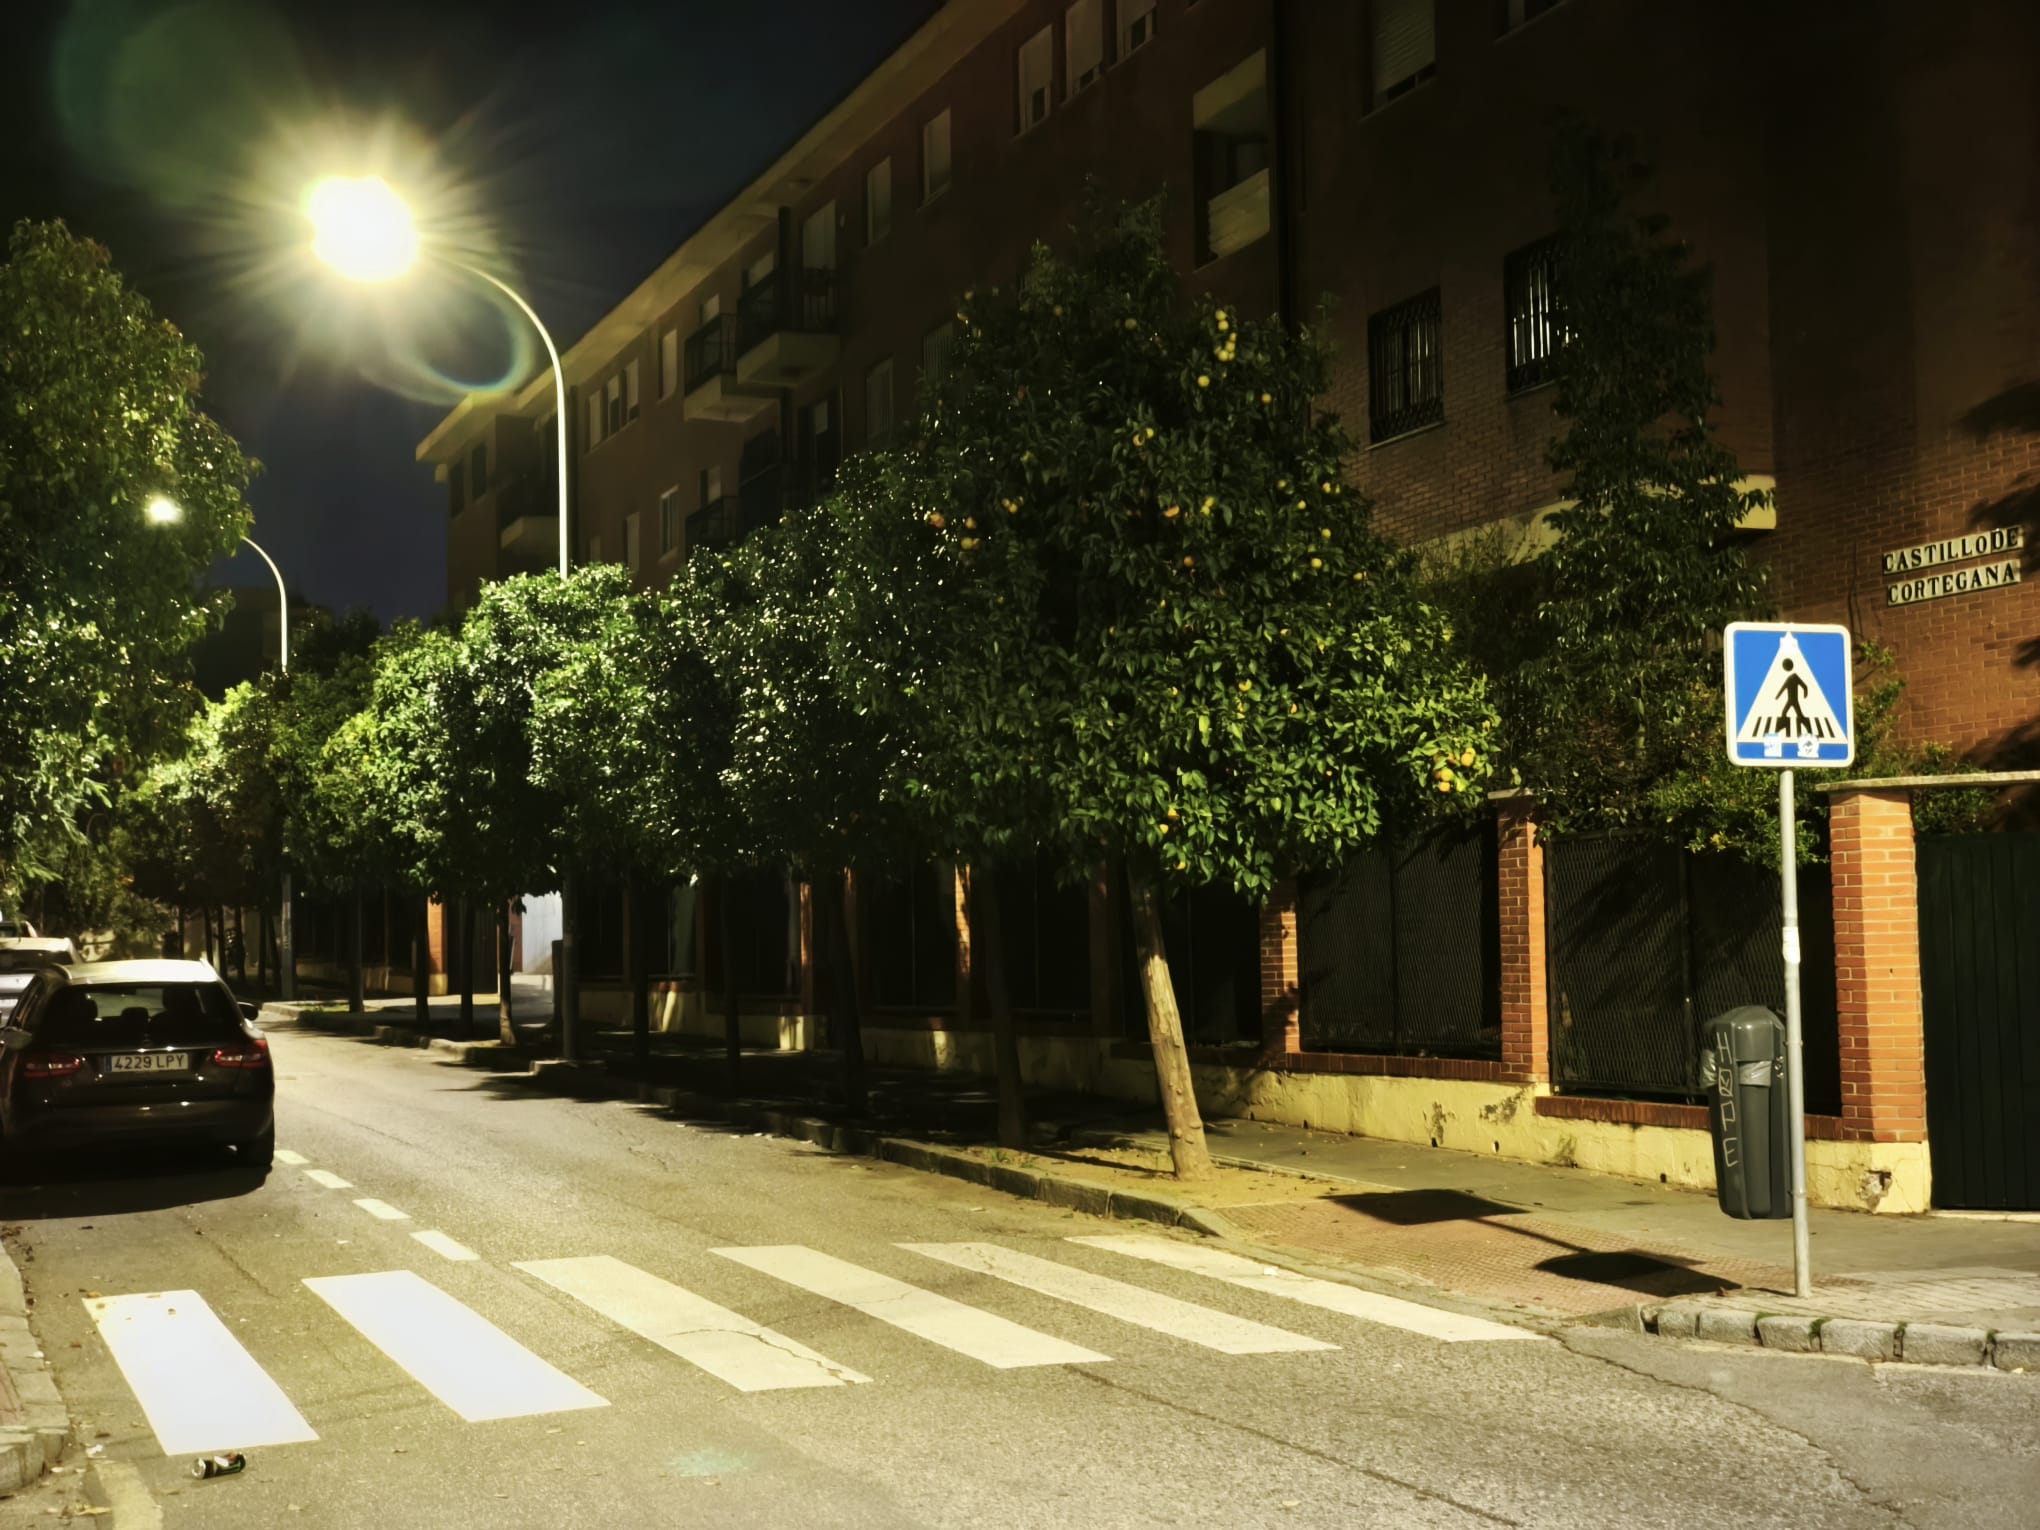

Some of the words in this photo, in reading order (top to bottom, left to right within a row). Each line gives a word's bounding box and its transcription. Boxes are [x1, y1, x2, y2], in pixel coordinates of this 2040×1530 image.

[1888, 562, 2015, 603] CORTEGANA
[114, 1056, 153, 1070] 4229
[156, 1054, 184, 1068] LPY
